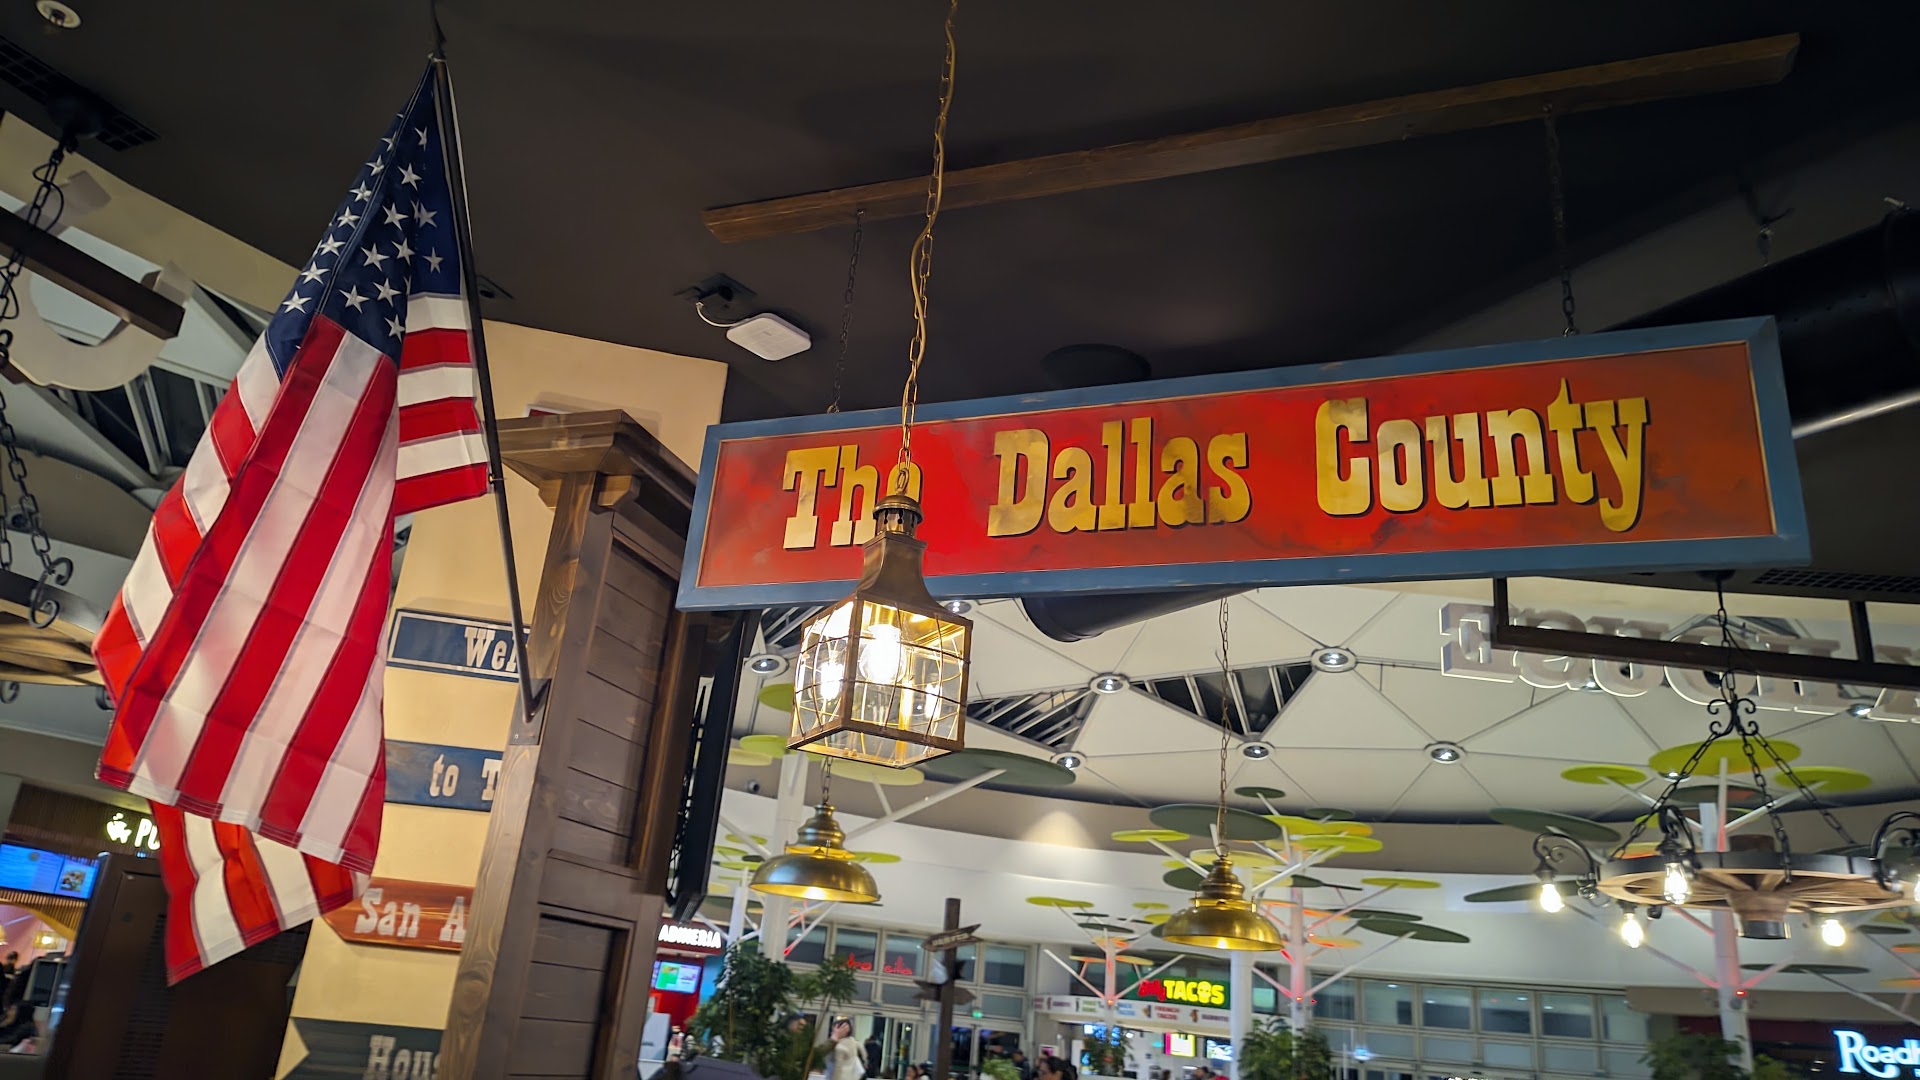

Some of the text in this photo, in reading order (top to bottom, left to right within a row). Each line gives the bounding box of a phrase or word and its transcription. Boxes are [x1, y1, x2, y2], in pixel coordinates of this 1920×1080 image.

[987, 417, 1251, 537] Dallas
[1315, 377, 1648, 532] County
[429, 754, 503, 801] to T
[354, 887, 466, 942] San A
[1163, 980, 1225, 1005] TACOS
